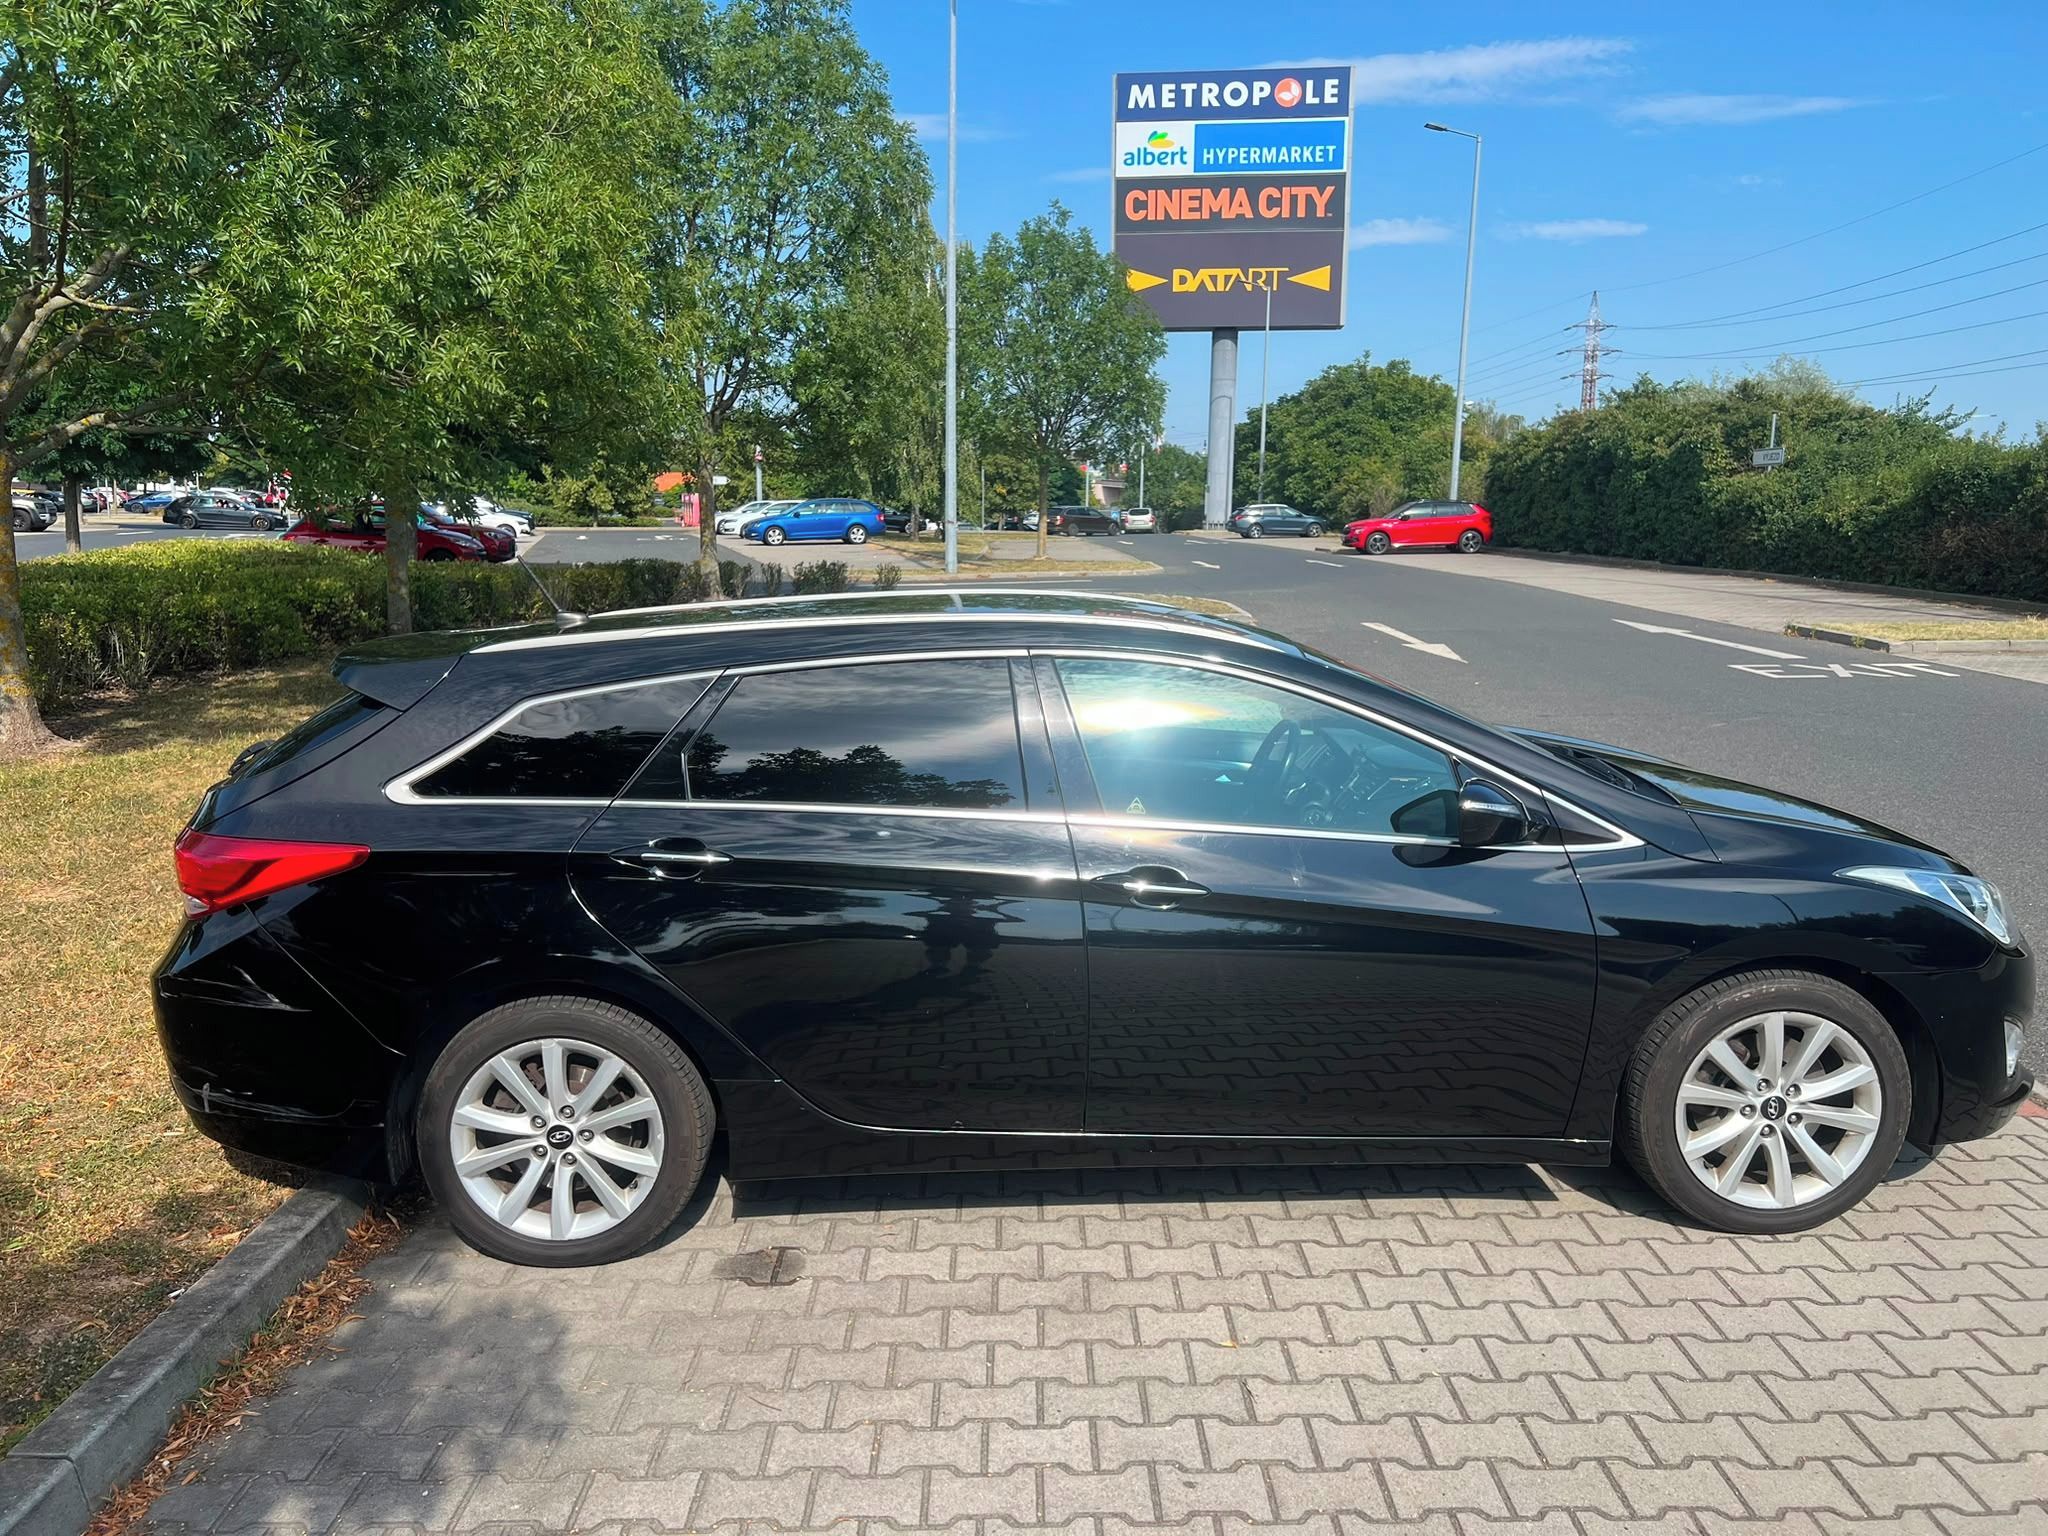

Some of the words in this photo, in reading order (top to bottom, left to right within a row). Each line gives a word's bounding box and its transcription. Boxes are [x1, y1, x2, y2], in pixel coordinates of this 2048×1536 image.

[1127, 77, 1339, 108] METROPOLE
[1123, 146, 1187, 166] albert
[1203, 145, 1336, 165] HYPERMARKET
[1125, 187, 1253, 221] CINEMA
[1258, 185, 1336, 219] CITY
[1172, 267, 1290, 292] DATART
[1727, 663, 1961, 678] EXIT
